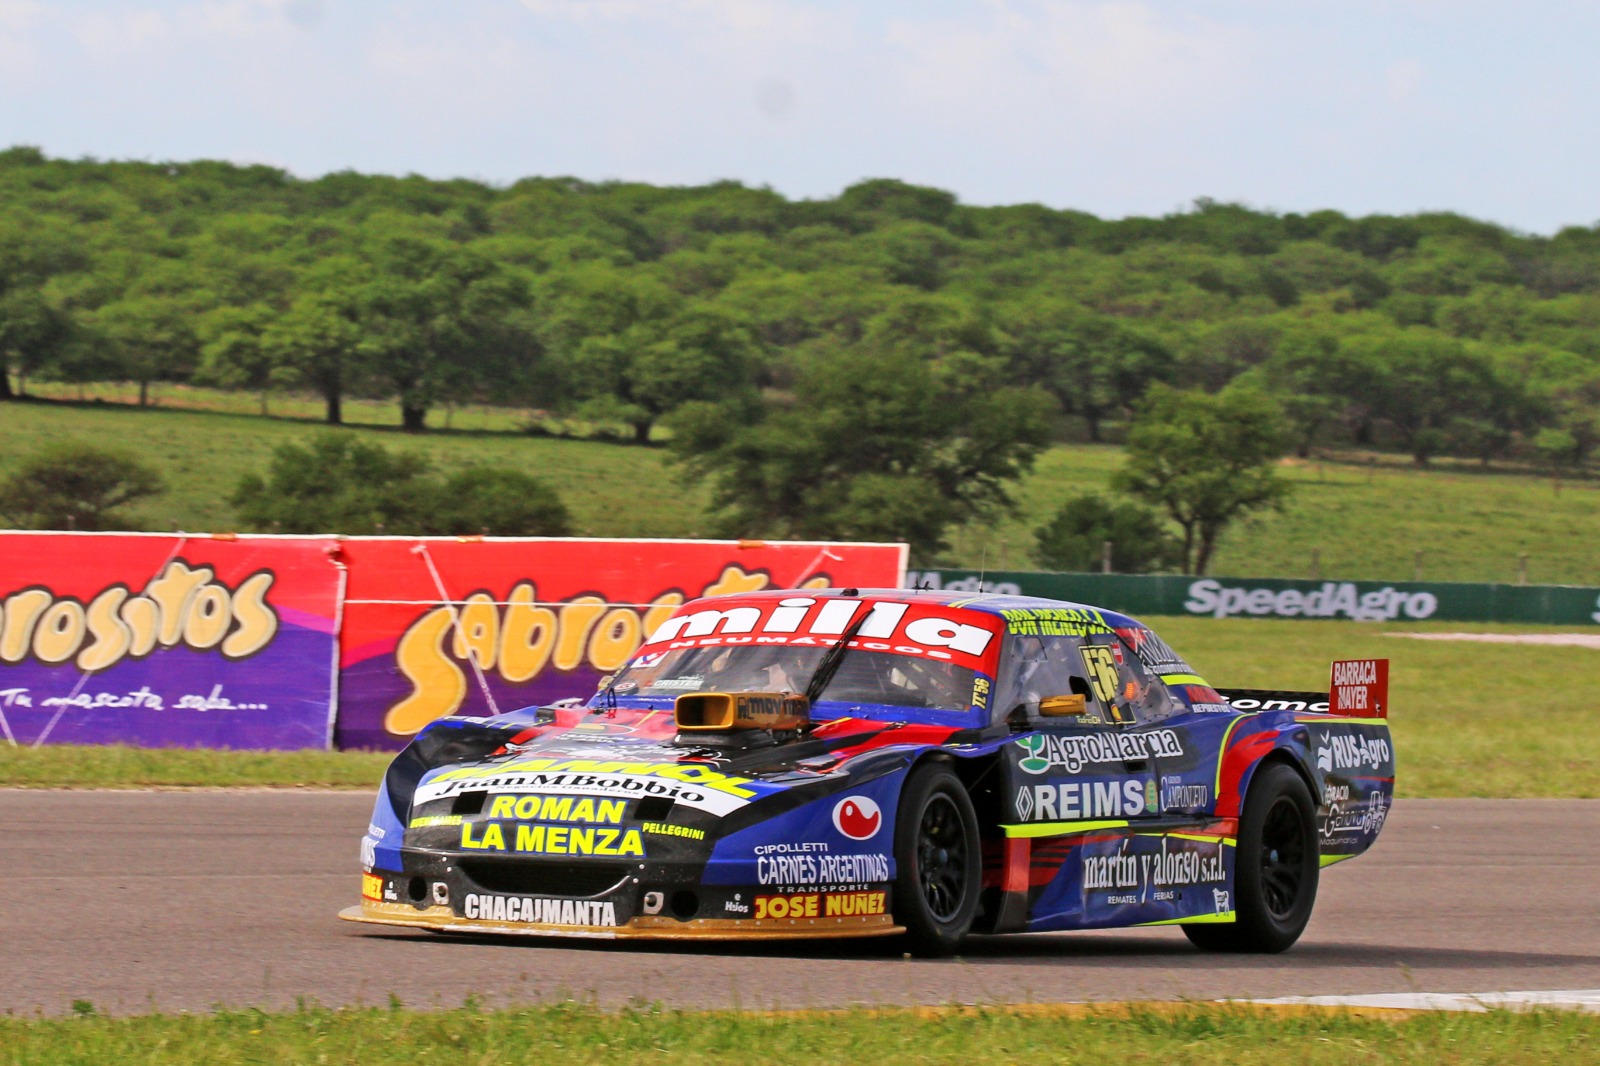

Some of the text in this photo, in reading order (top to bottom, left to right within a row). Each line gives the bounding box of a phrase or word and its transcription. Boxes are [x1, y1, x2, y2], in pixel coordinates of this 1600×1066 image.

[1184, 579, 1437, 622] SpeedAgro
[647, 597, 994, 656] milla
[1082, 648, 1119, 703] 56
[1334, 661, 1376, 686] BARRACA
[0, 688, 33, 708] Tu
[41, 686, 164, 711] mascota
[1338, 686, 1368, 709] MAYER
[489, 796, 626, 824] ROMAN
[1035, 779, 1145, 820] REIMS
[461, 822, 644, 856] LA MENZA
[642, 822, 704, 840] PELLEGRINI
[754, 842, 828, 855] CIPOLLETTI
[757, 853, 888, 885] CARNES ARGENTINAS
[1084, 839, 1138, 888] martín
[1141, 854, 1150, 904] y
[1153, 837, 1199, 885] alonso
[777, 883, 869, 893] TRANSPORTE
[1107, 891, 1174, 904] REMATES FERIAS
[755, 893, 885, 919] JOSE NUÑEZ
